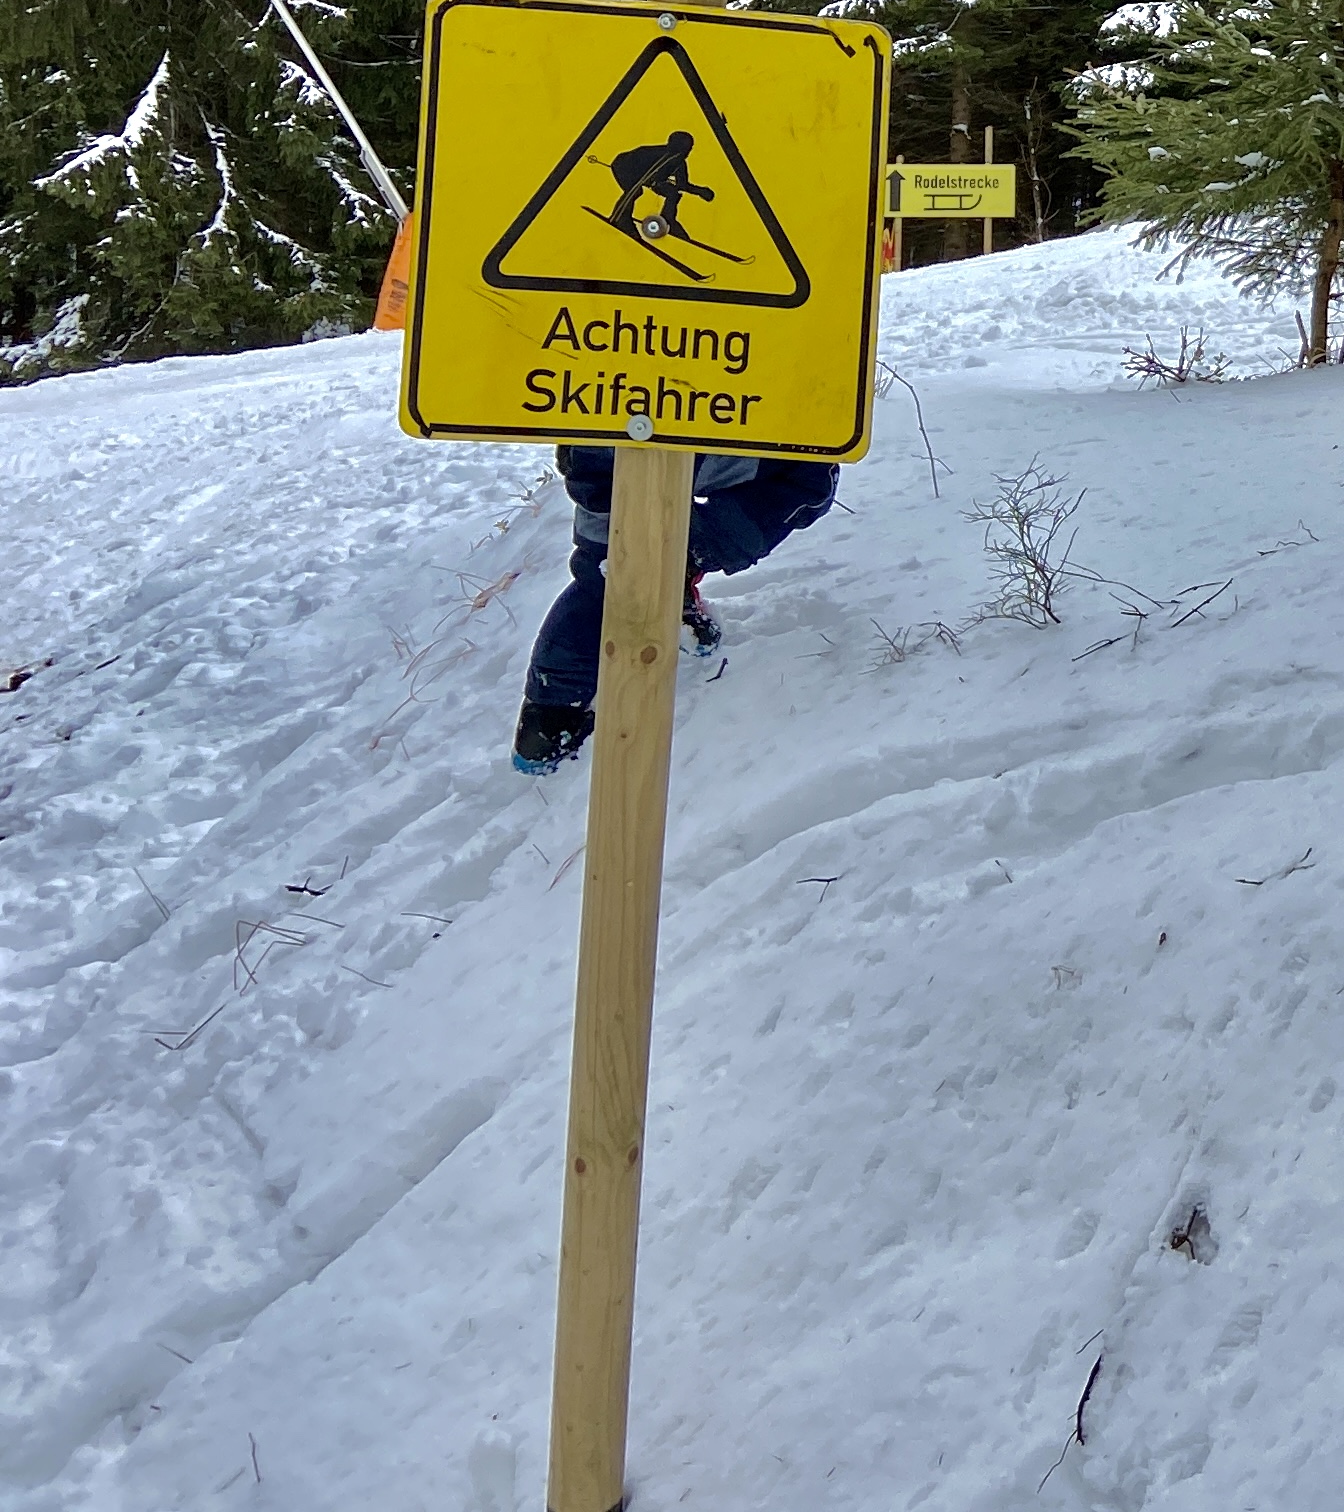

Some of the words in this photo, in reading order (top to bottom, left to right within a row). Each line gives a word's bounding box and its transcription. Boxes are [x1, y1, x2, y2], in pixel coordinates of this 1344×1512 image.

[914, 174, 999, 189] Rodelstrecke
[540, 306, 751, 374] Achtung
[521, 368, 764, 426] Skifahrer
